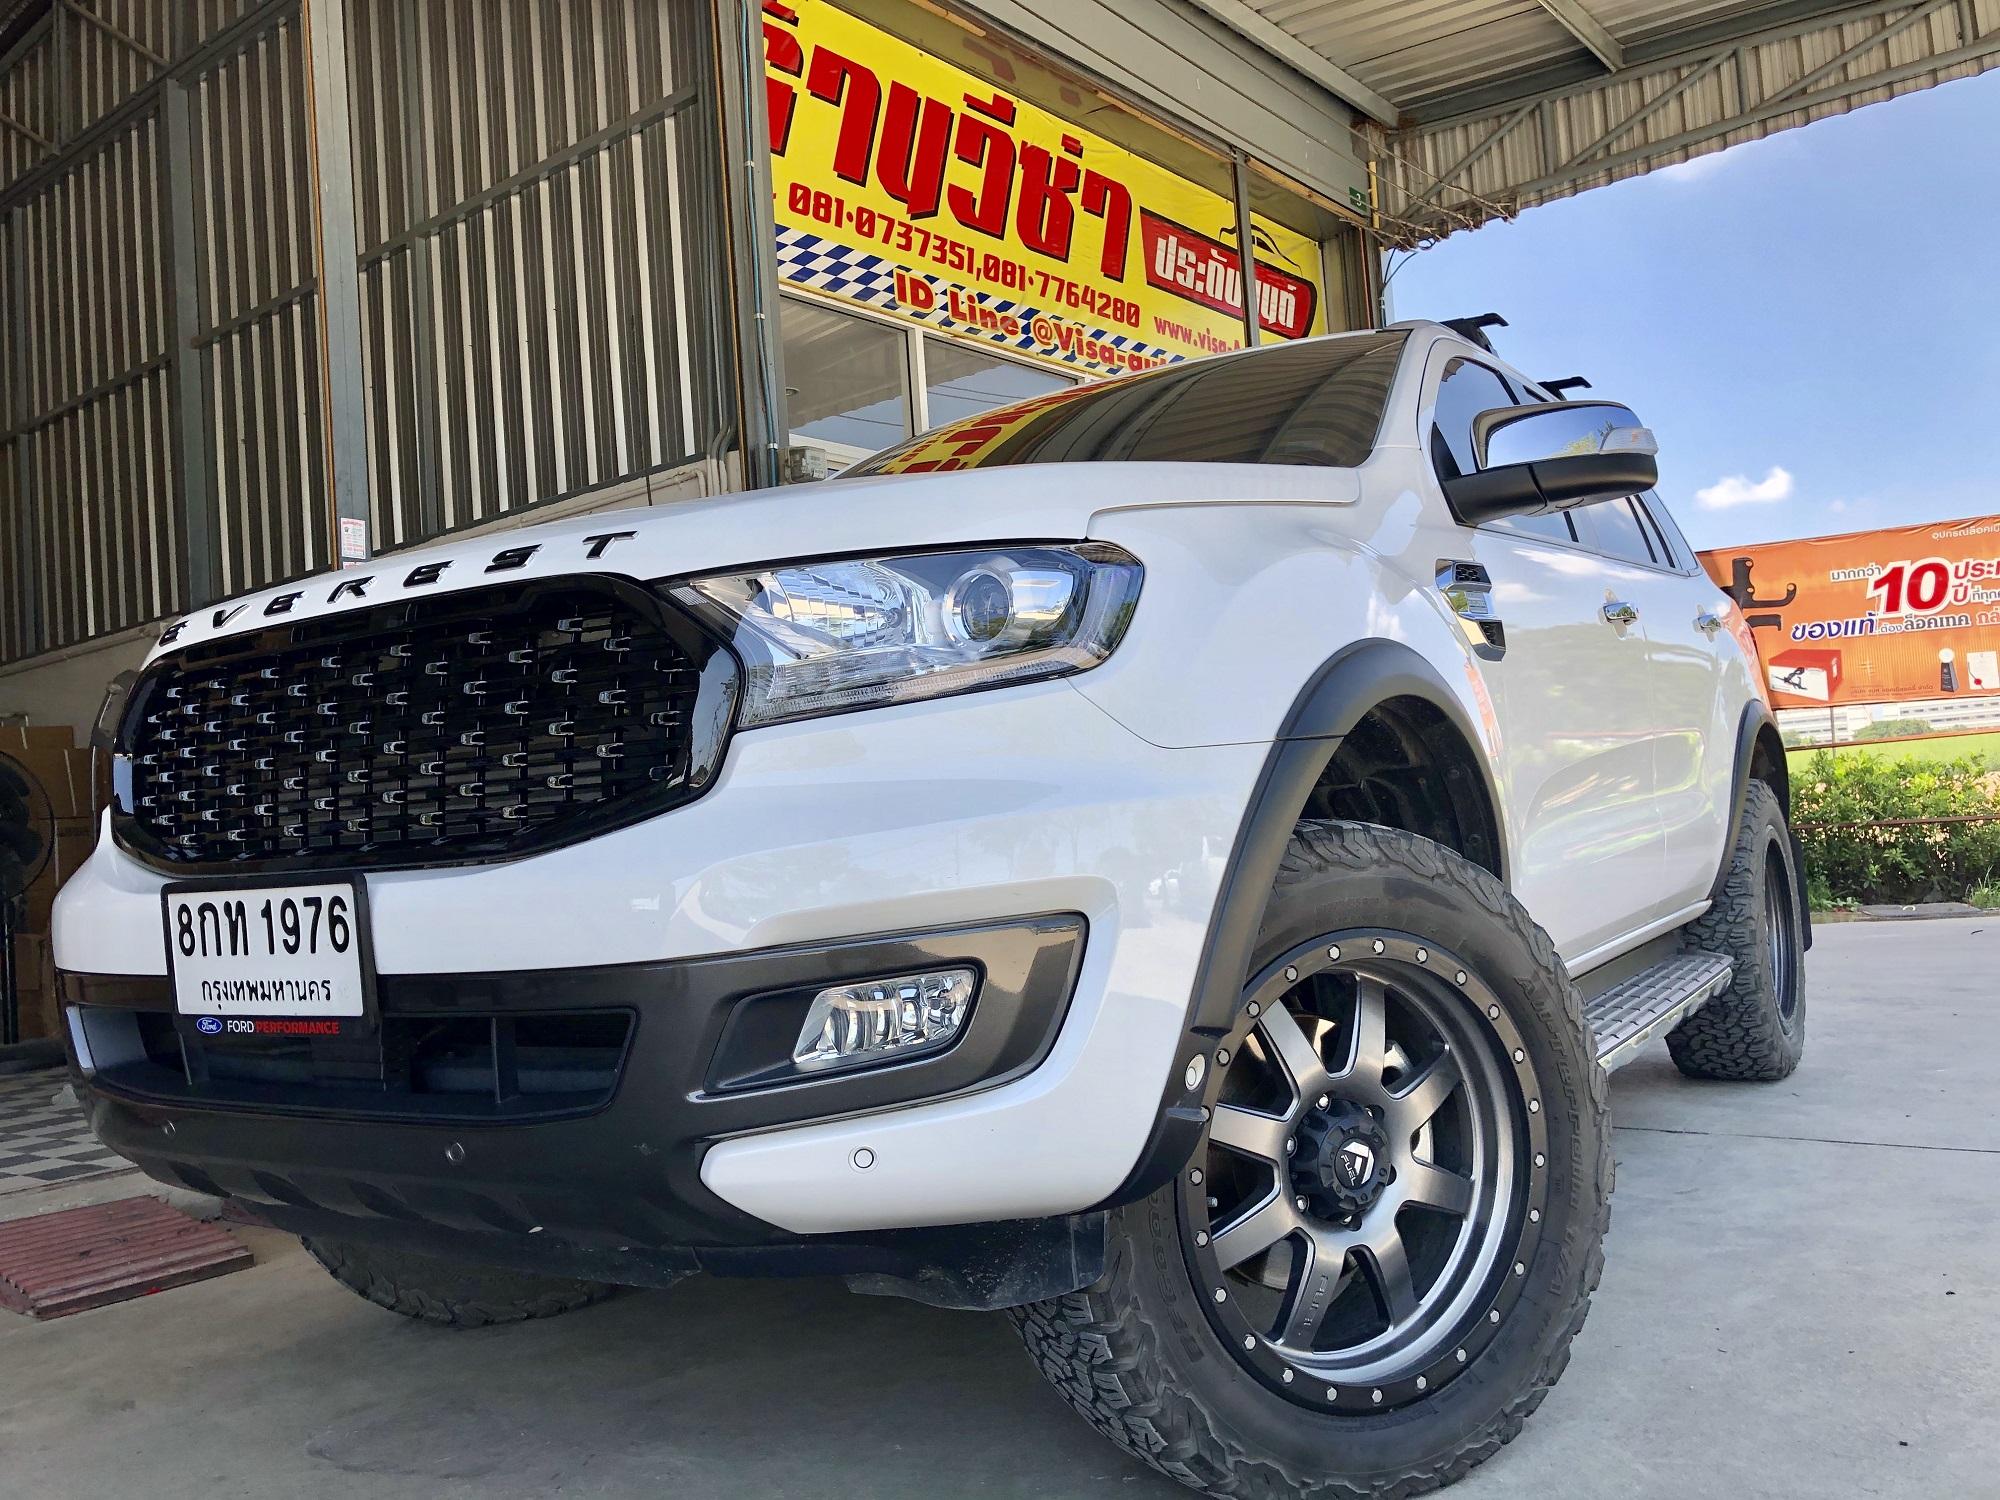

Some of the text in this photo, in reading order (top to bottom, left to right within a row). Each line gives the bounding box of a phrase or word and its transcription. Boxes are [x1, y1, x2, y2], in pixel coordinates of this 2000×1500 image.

[895, 271, 935, 311] ID
[948, 290, 1020, 337] Line
[158, 530, 639, 648] EVEREST
[1873, 562, 1950, 614] 10
[177, 895, 350, 957] 8กท 1976
[201, 979, 331, 1010] กรุงเทพมหานคร
[227, 1020, 254, 1033] FORD
[255, 1021, 340, 1034] PERFORMANCE
[1341, 1154, 1355, 1187] FUEL
